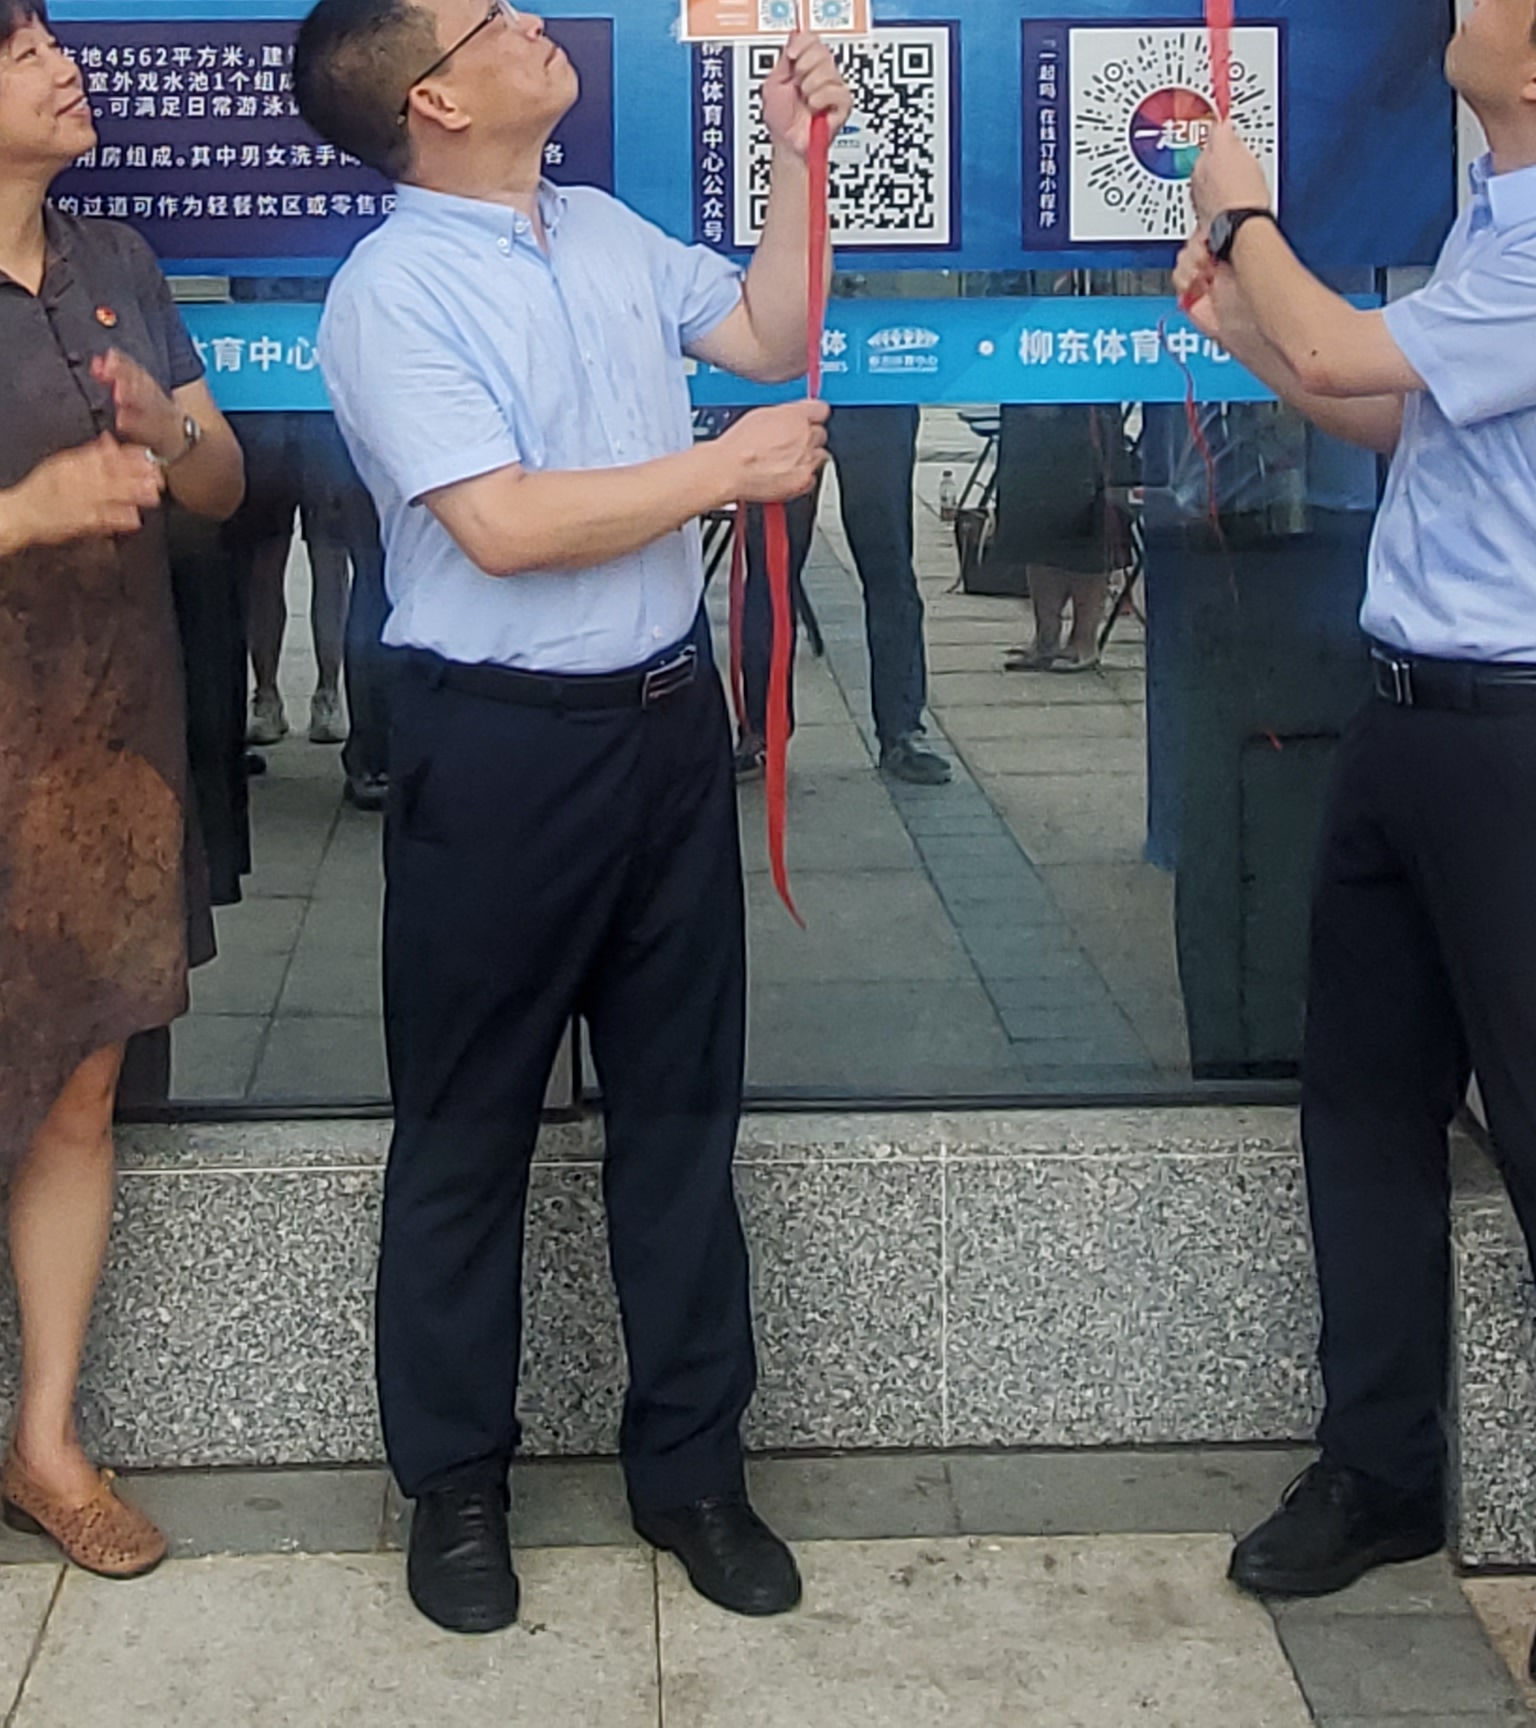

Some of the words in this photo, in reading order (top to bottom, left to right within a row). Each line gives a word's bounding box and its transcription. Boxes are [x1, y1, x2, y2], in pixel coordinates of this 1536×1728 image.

[701, 41, 725, 243] 柳东体育中心公众号
[1018, 326, 1232, 365] 柳东体育中心
